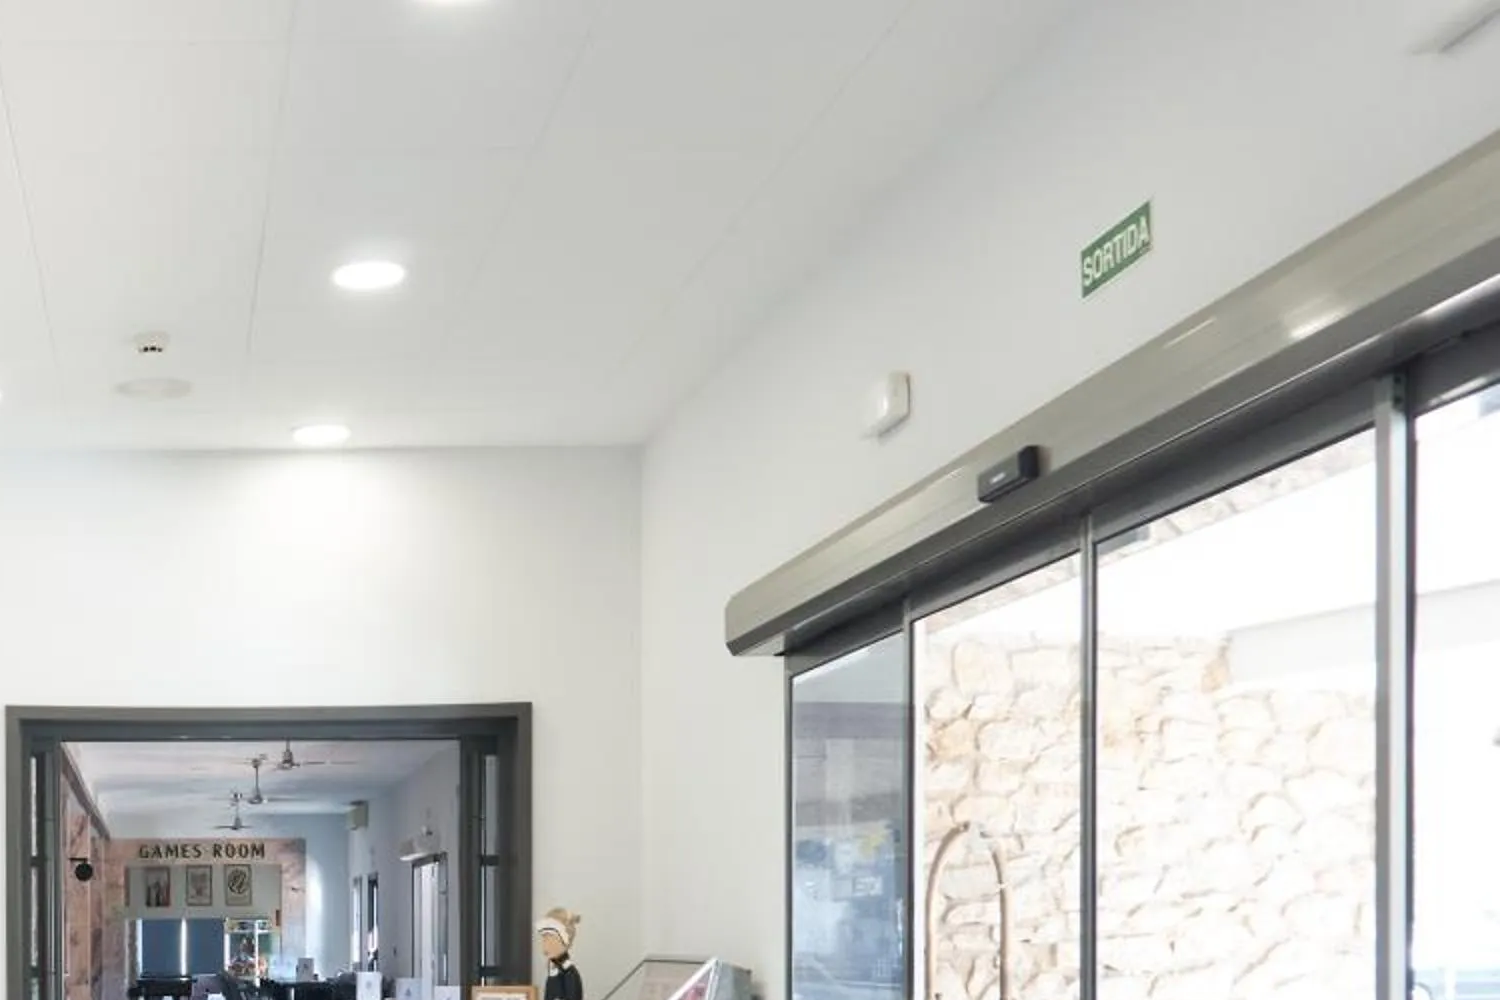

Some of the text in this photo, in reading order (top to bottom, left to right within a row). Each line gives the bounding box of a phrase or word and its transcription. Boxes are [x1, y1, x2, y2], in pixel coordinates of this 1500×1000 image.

[1083, 215, 1151, 287] SORTIDA
[138, 843, 265, 859] GAMES ROOM
